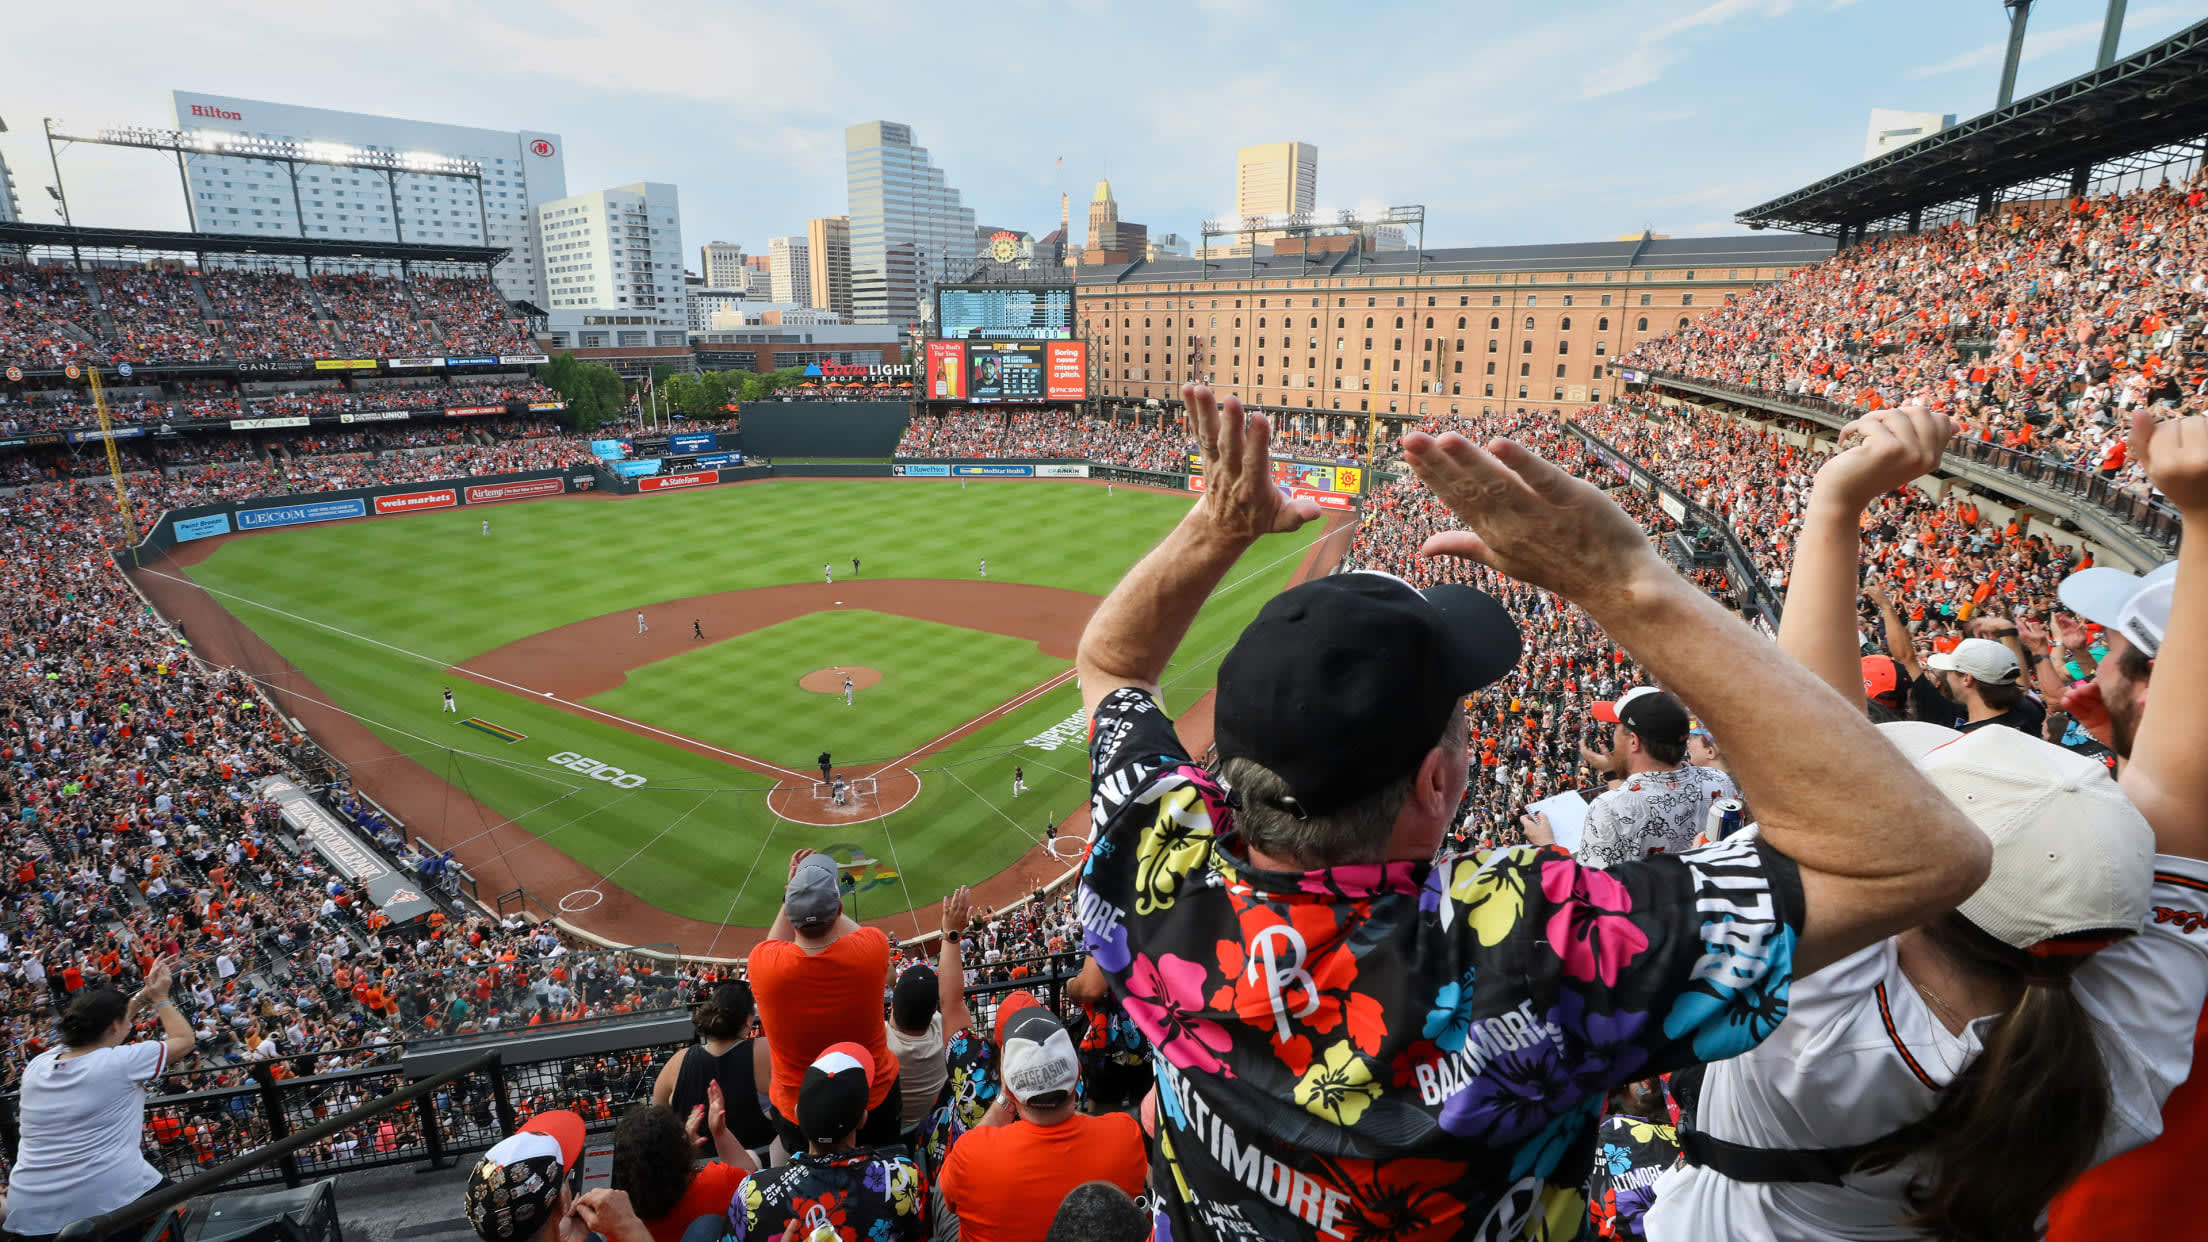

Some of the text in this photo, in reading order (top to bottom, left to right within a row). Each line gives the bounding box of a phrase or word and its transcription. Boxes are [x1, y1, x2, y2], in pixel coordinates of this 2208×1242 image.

[191, 104, 242, 120] Hilton
[239, 363, 277, 371] GANZ
[821, 358, 912, 376] Coors LIGHT
[383, 411, 409, 419] UNION
[381, 493, 450, 507] weis markets
[472, 488, 503, 498] Airtemp
[547, 752, 647, 788] GEICO
[1247, 924, 1320, 1044] B
[1612, 1164, 1663, 1193] ALTIMORE
